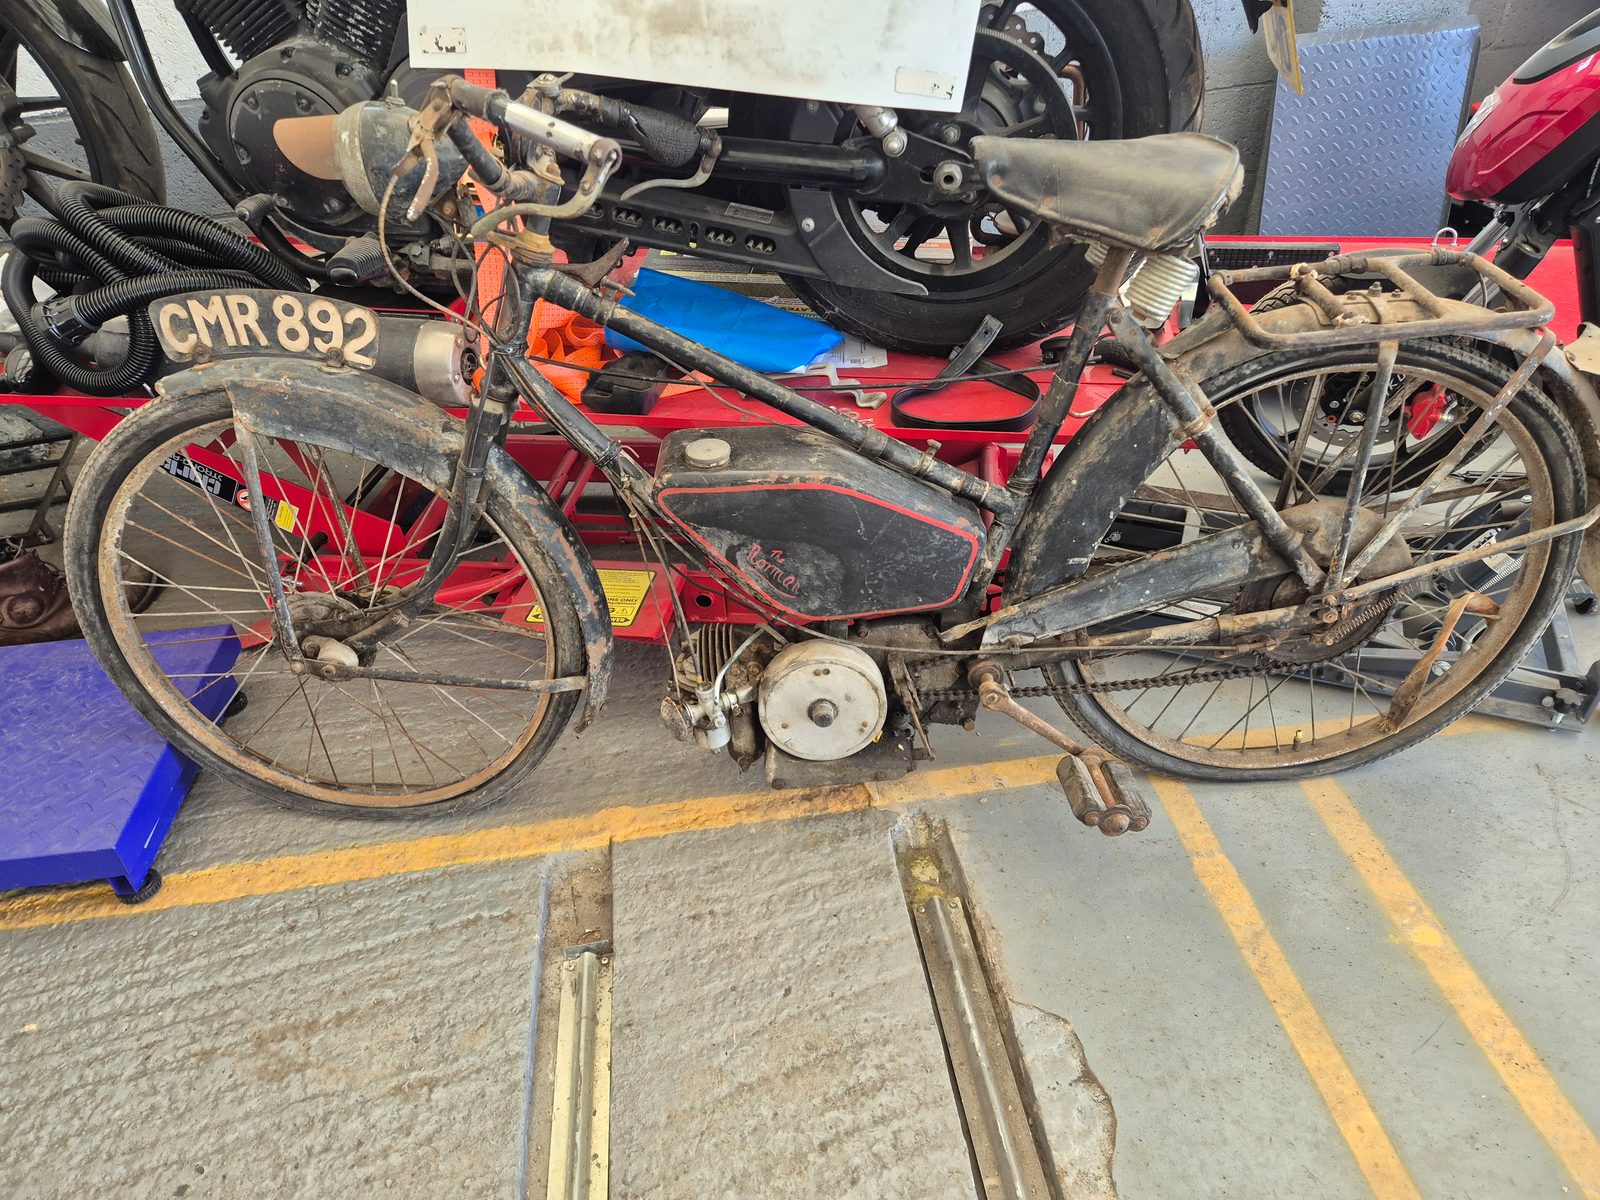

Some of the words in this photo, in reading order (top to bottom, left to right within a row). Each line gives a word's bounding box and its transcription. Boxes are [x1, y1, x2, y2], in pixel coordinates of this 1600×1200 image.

[159, 294, 270, 354] CMR
[272, 294, 377, 366] 892
[163, 457, 222, 495] Clark
[747, 543, 801, 595] Norman
[770, 549, 785, 563] The
